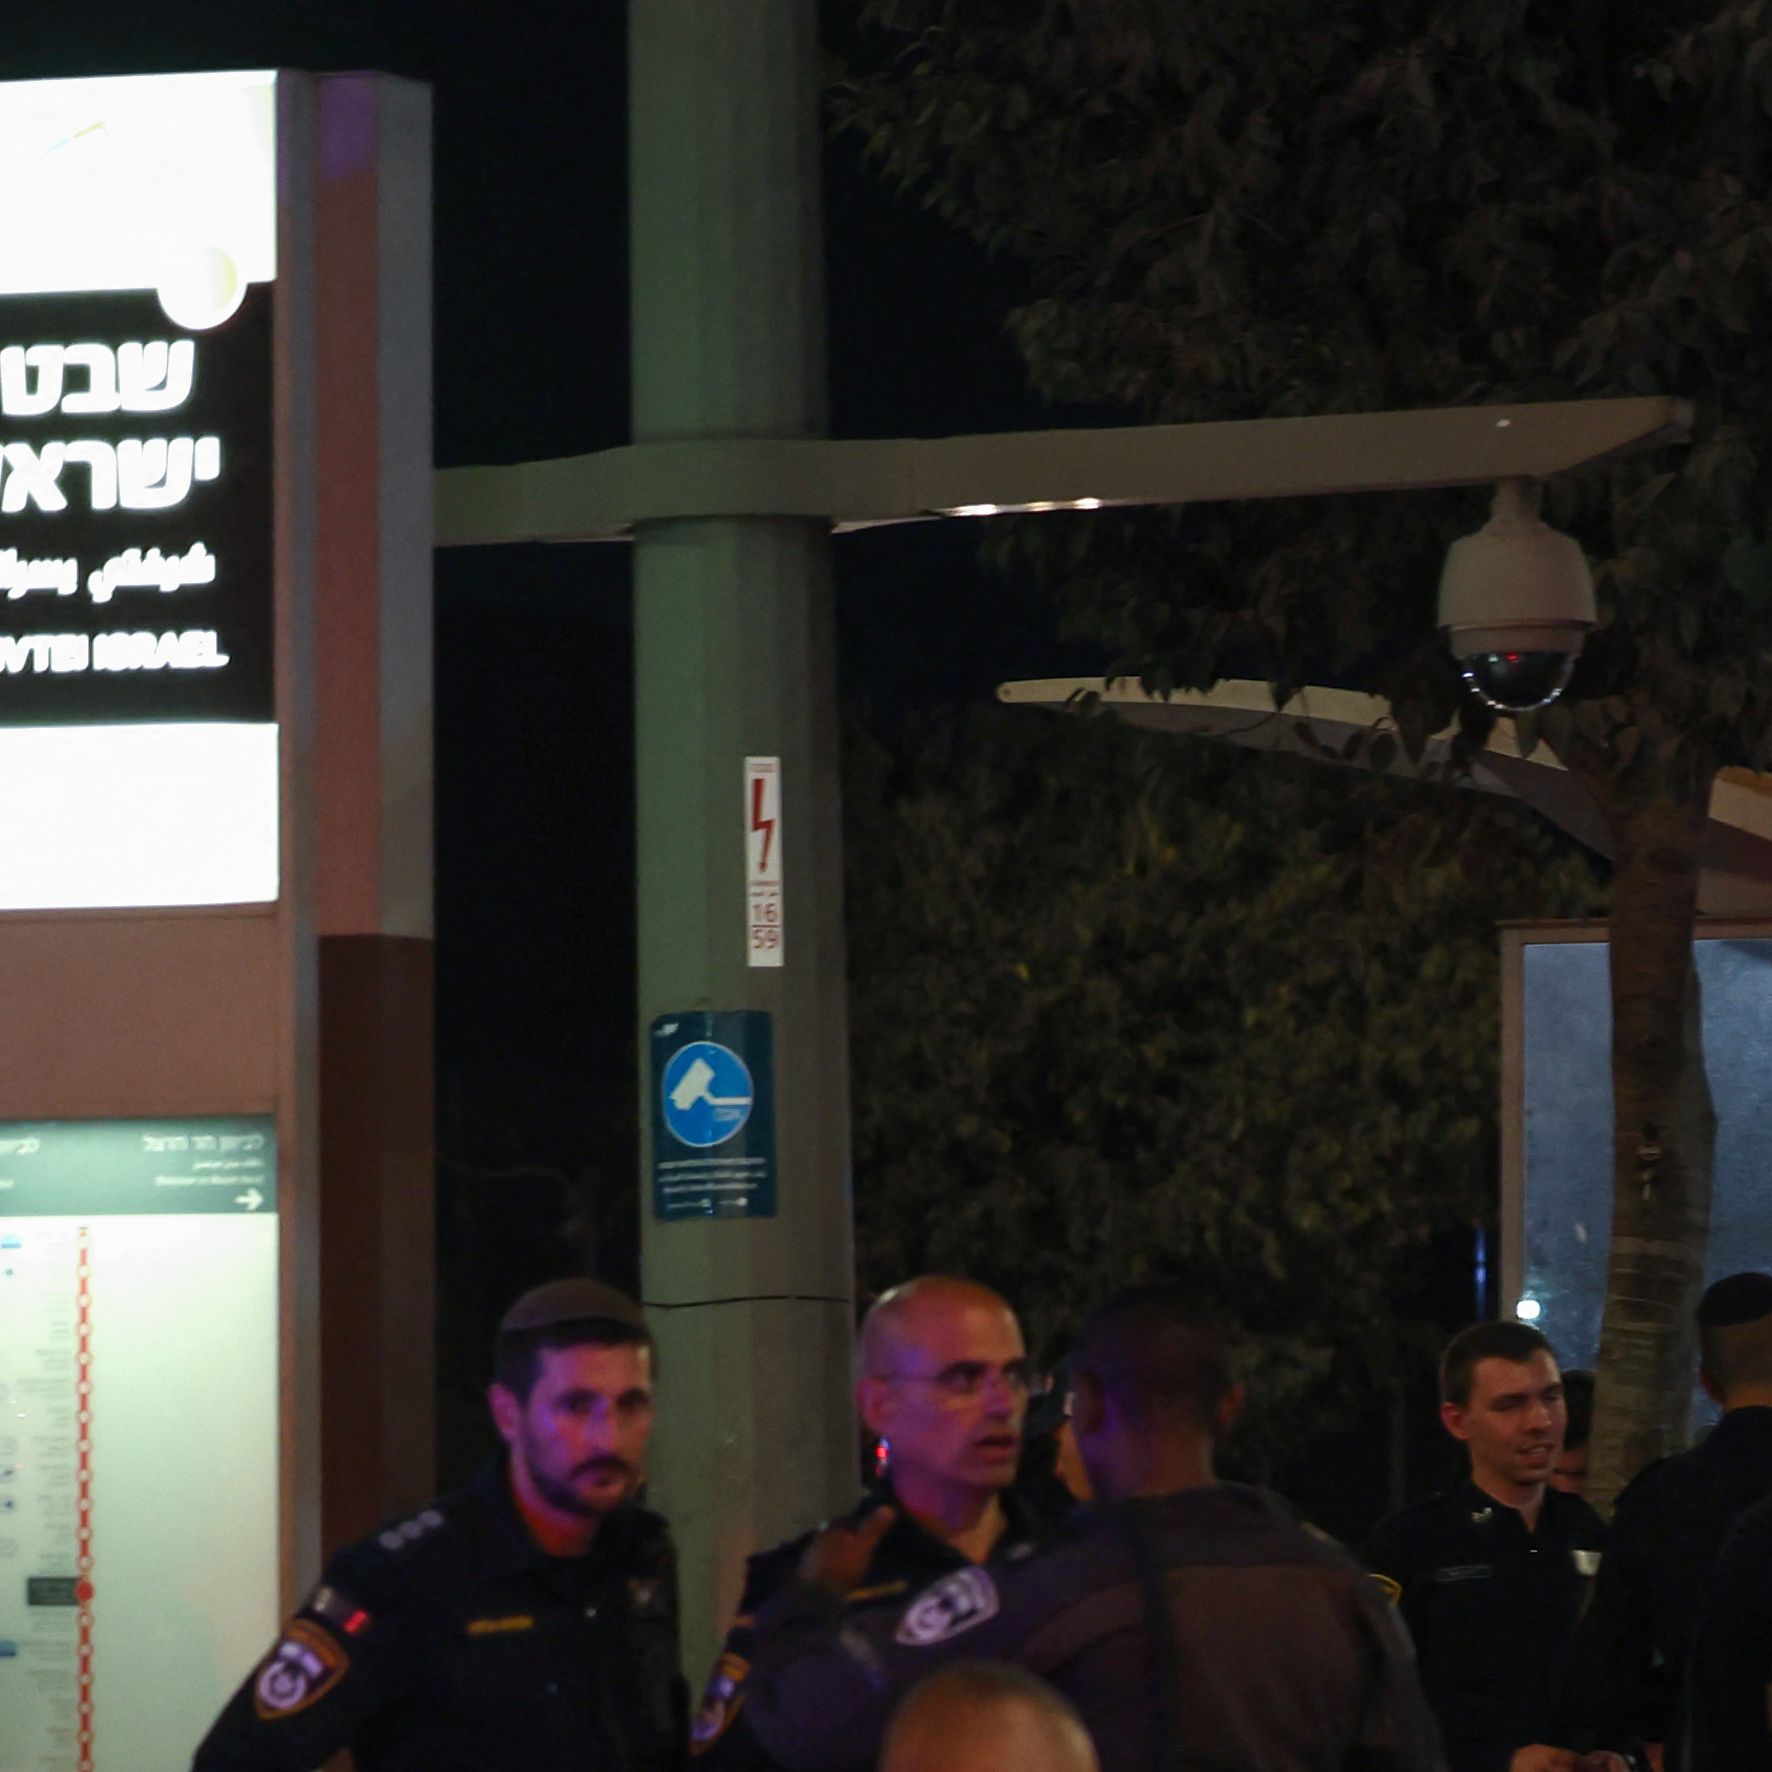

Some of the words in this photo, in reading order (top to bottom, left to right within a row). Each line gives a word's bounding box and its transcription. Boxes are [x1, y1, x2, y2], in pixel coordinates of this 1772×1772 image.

[0, 339, 196, 416] שבט
[0, 435, 221, 513] ישרא
[0, 633, 90, 675] VTEI
